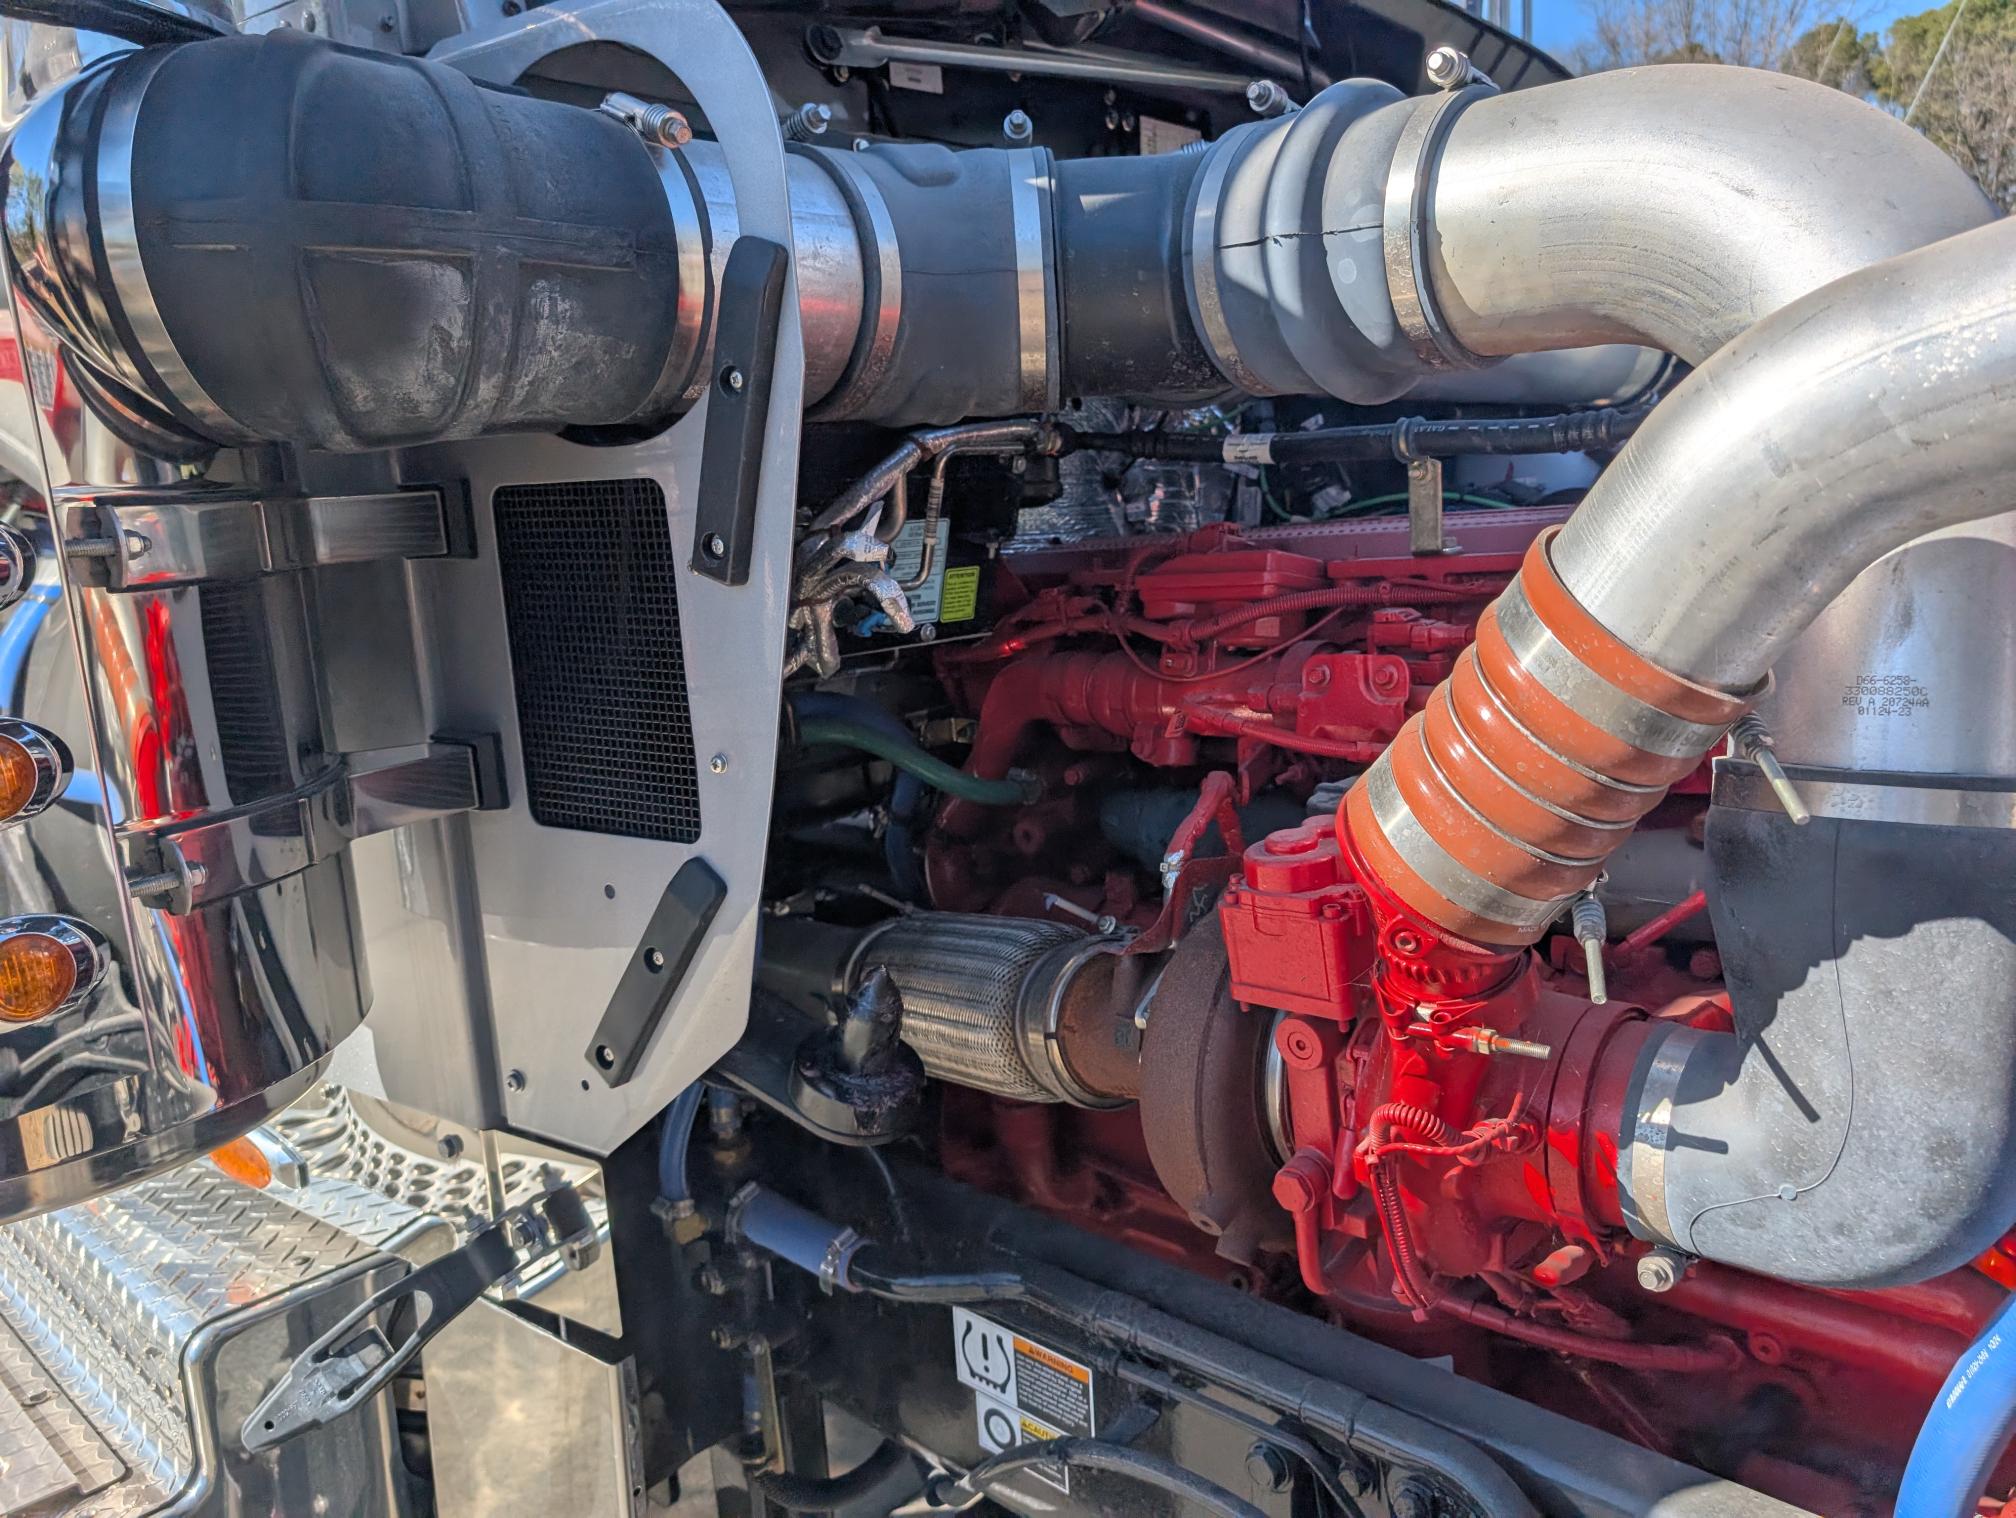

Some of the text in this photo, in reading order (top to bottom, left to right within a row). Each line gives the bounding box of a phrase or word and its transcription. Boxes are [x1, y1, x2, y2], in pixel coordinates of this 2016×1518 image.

[1842, 697, 1862, 706] REV
[1868, 697, 1876, 707] A
[1857, 706, 1912, 717] 01124-23
[1033, 1347, 1074, 1374] WARNING
